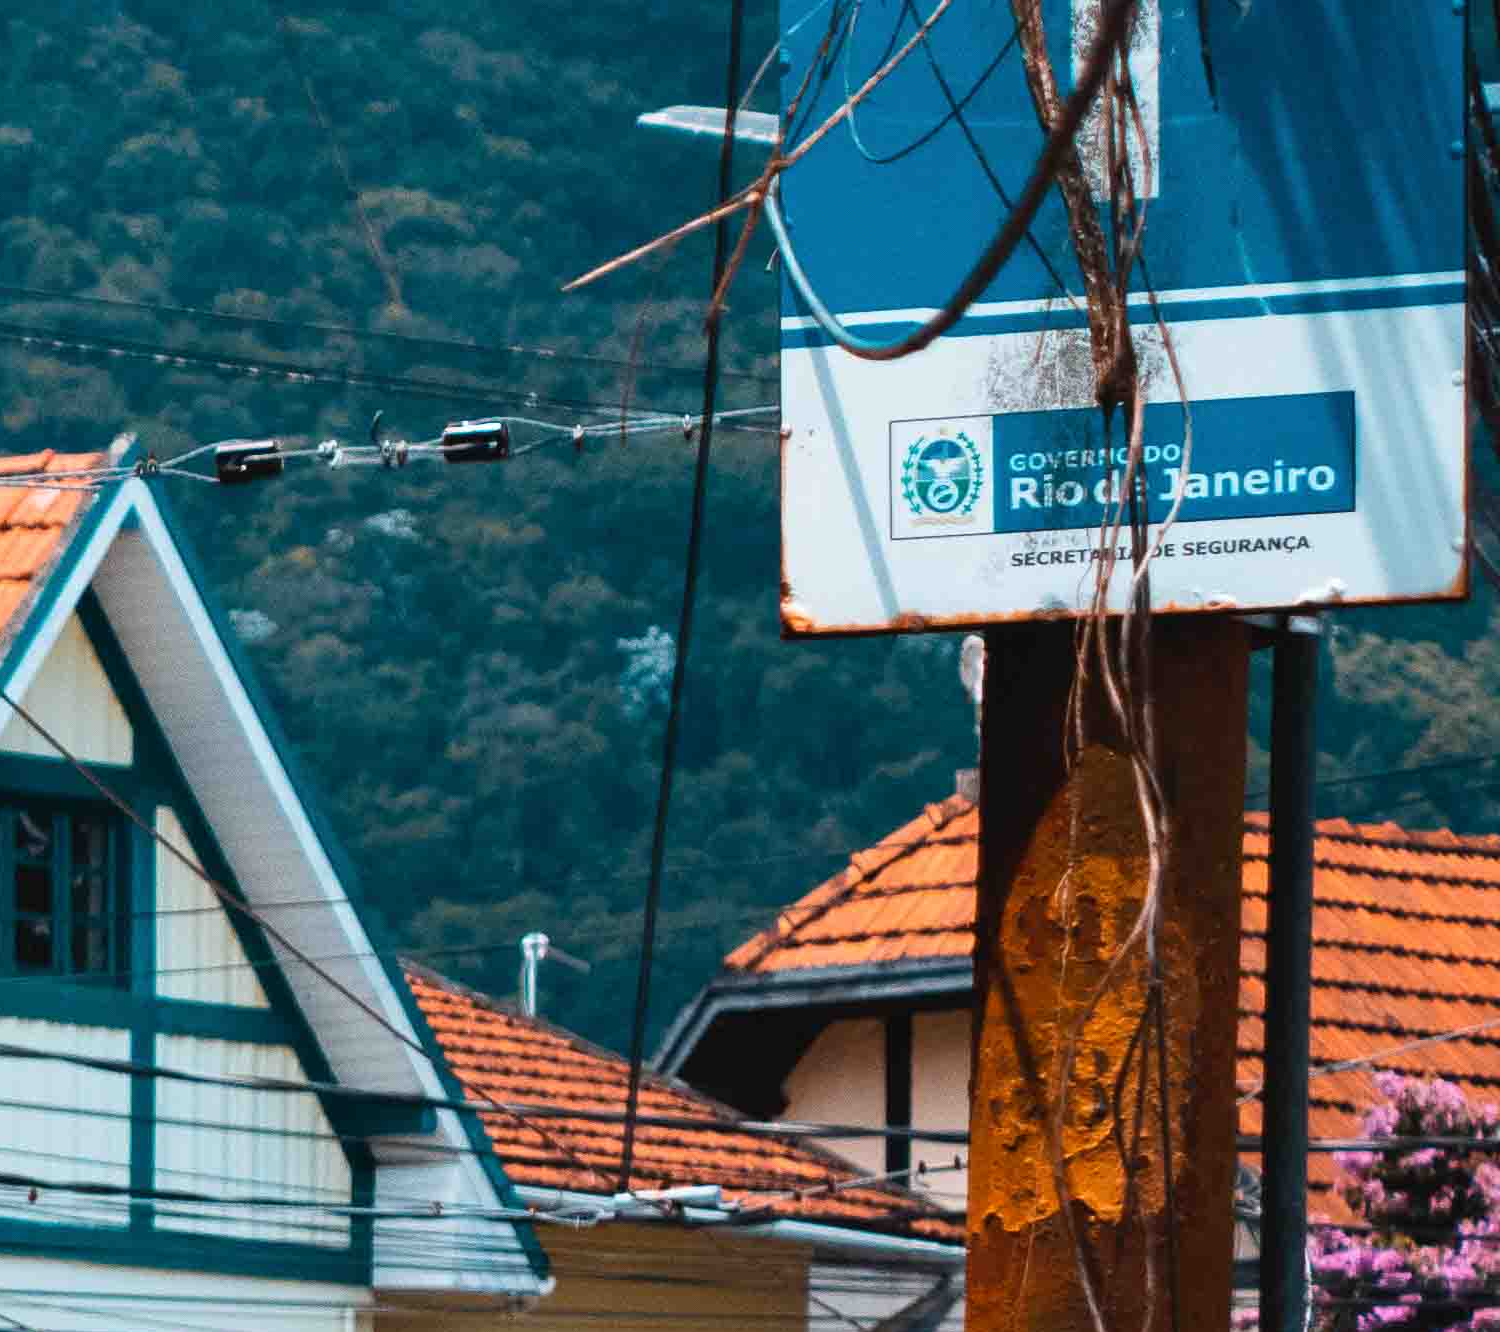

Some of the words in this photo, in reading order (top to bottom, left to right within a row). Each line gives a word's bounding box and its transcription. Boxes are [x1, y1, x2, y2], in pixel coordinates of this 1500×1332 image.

[1144, 442, 1182, 465] DO
[1010, 473, 1084, 510] Rio
[1158, 459, 1336, 502] Janeiro
[1182, 535, 1311, 557] SEGURANÇA
